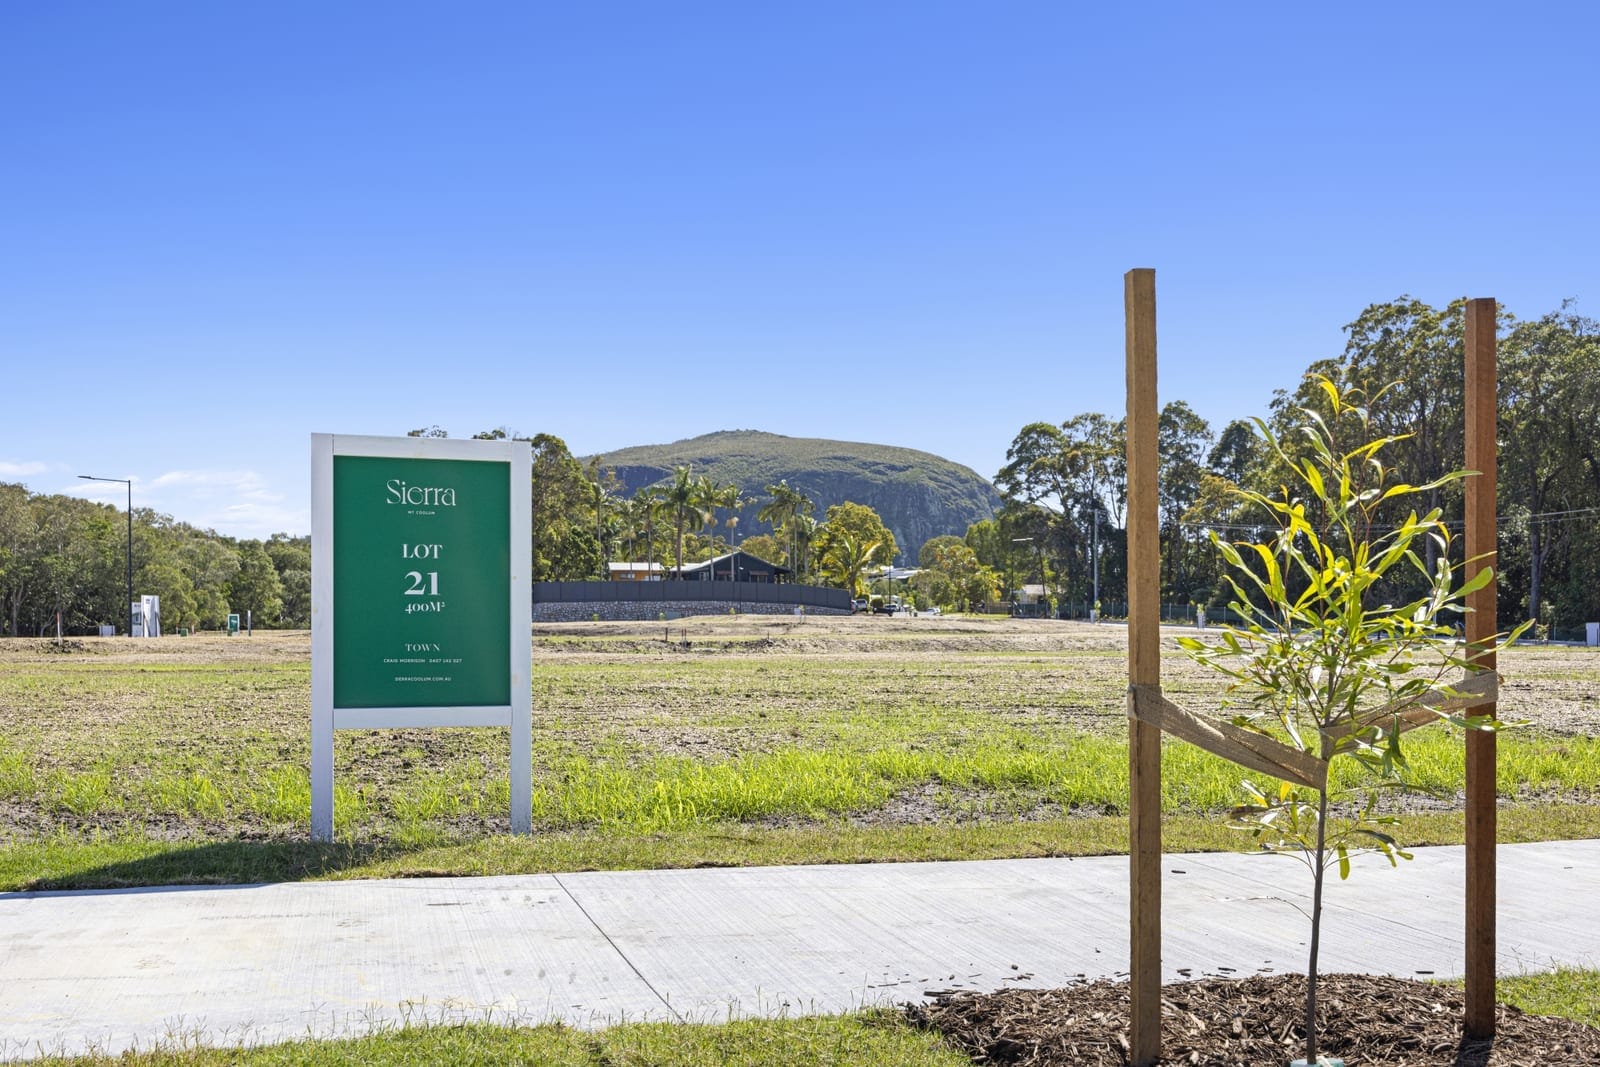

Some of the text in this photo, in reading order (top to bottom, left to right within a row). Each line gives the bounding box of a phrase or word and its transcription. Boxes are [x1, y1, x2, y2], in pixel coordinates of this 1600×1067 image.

[386, 479, 457, 507] Sierra
[402, 543, 443, 559] LOT
[404, 571, 441, 595] 21
[405, 643, 441, 652] TOWN
